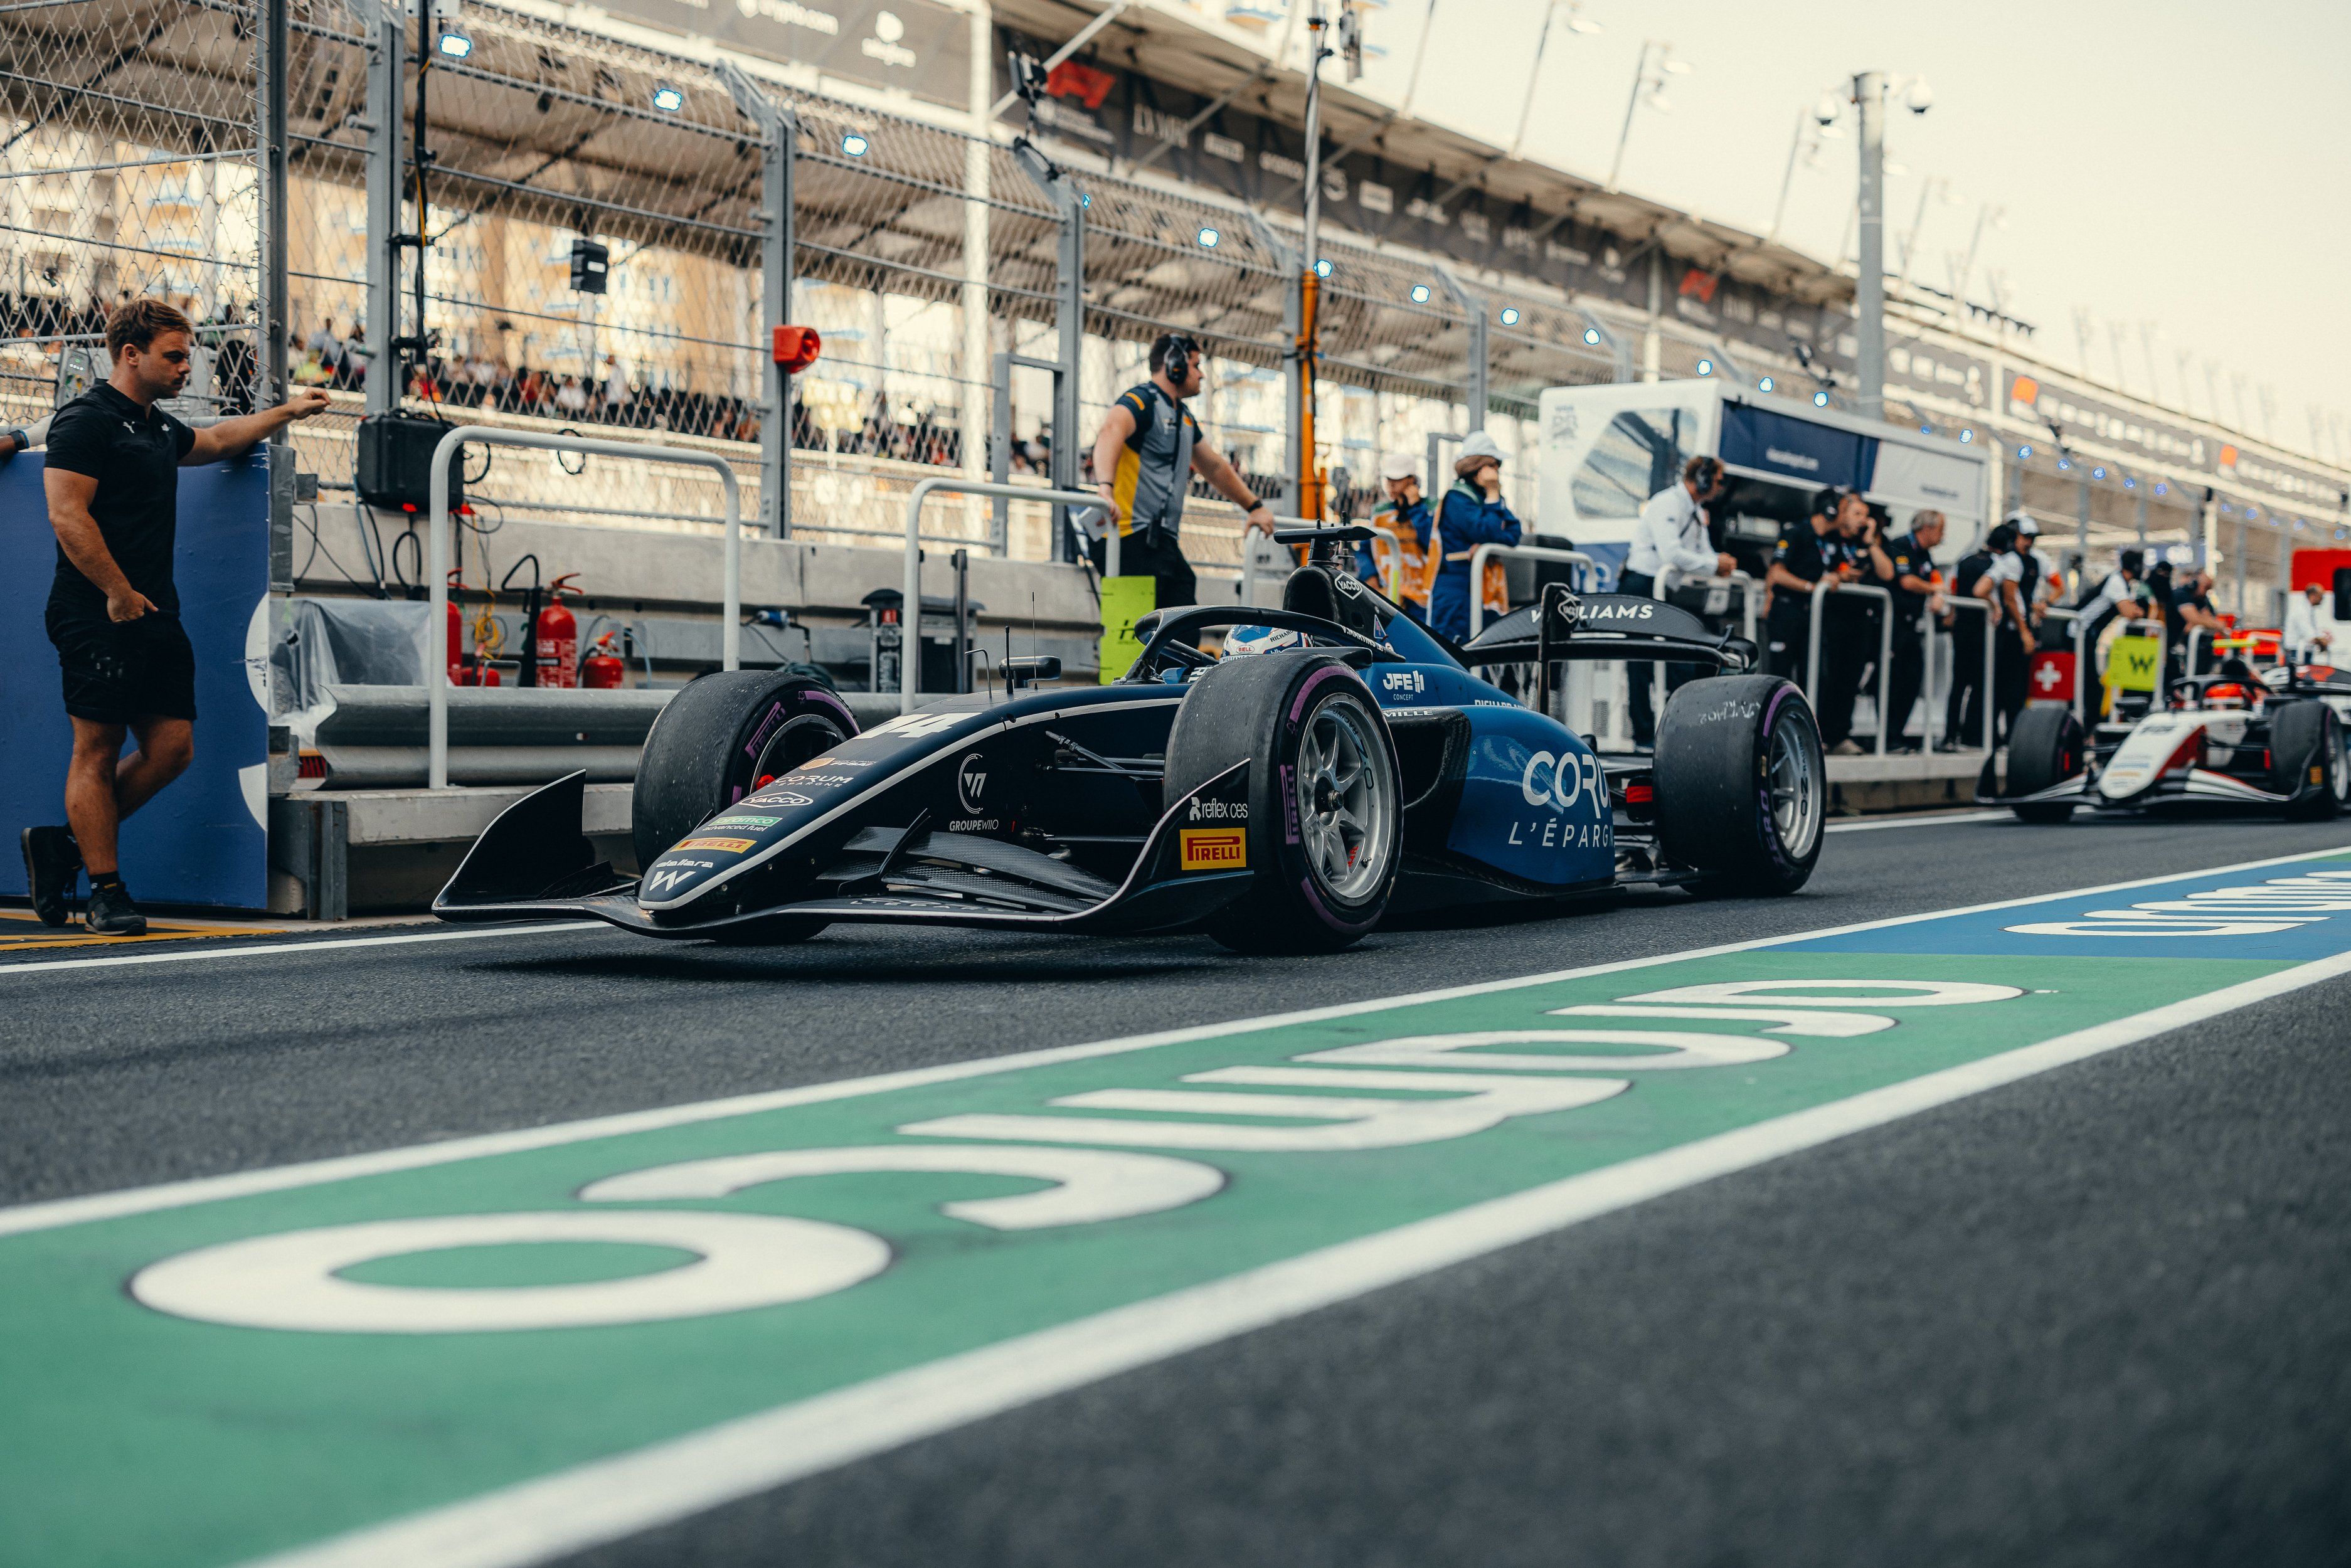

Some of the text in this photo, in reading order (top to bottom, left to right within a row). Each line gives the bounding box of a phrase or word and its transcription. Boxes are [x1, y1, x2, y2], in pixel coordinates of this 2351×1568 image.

[1337, 580, 1361, 591] YACCO
[1531, 604, 1654, 623] WLIAMS
[1382, 672, 1413, 691] JFE
[851, 712, 983, 740] 14
[775, 775, 854, 785] CORUM
[1522, 750, 1611, 819] CORU
[749, 796, 805, 805] YACCO
[1202, 798, 1248, 818] reflex ces
[1279, 764, 1300, 845] PIRELLI
[718, 817, 774, 825] aramco
[1508, 817, 1614, 848] L'ÉPARGN
[679, 839, 748, 849] PIRELLI
[1187, 835, 1241, 862] PIRELLI
[656, 859, 714, 868] dallara
[129, 978, 2027, 1335] aramco
